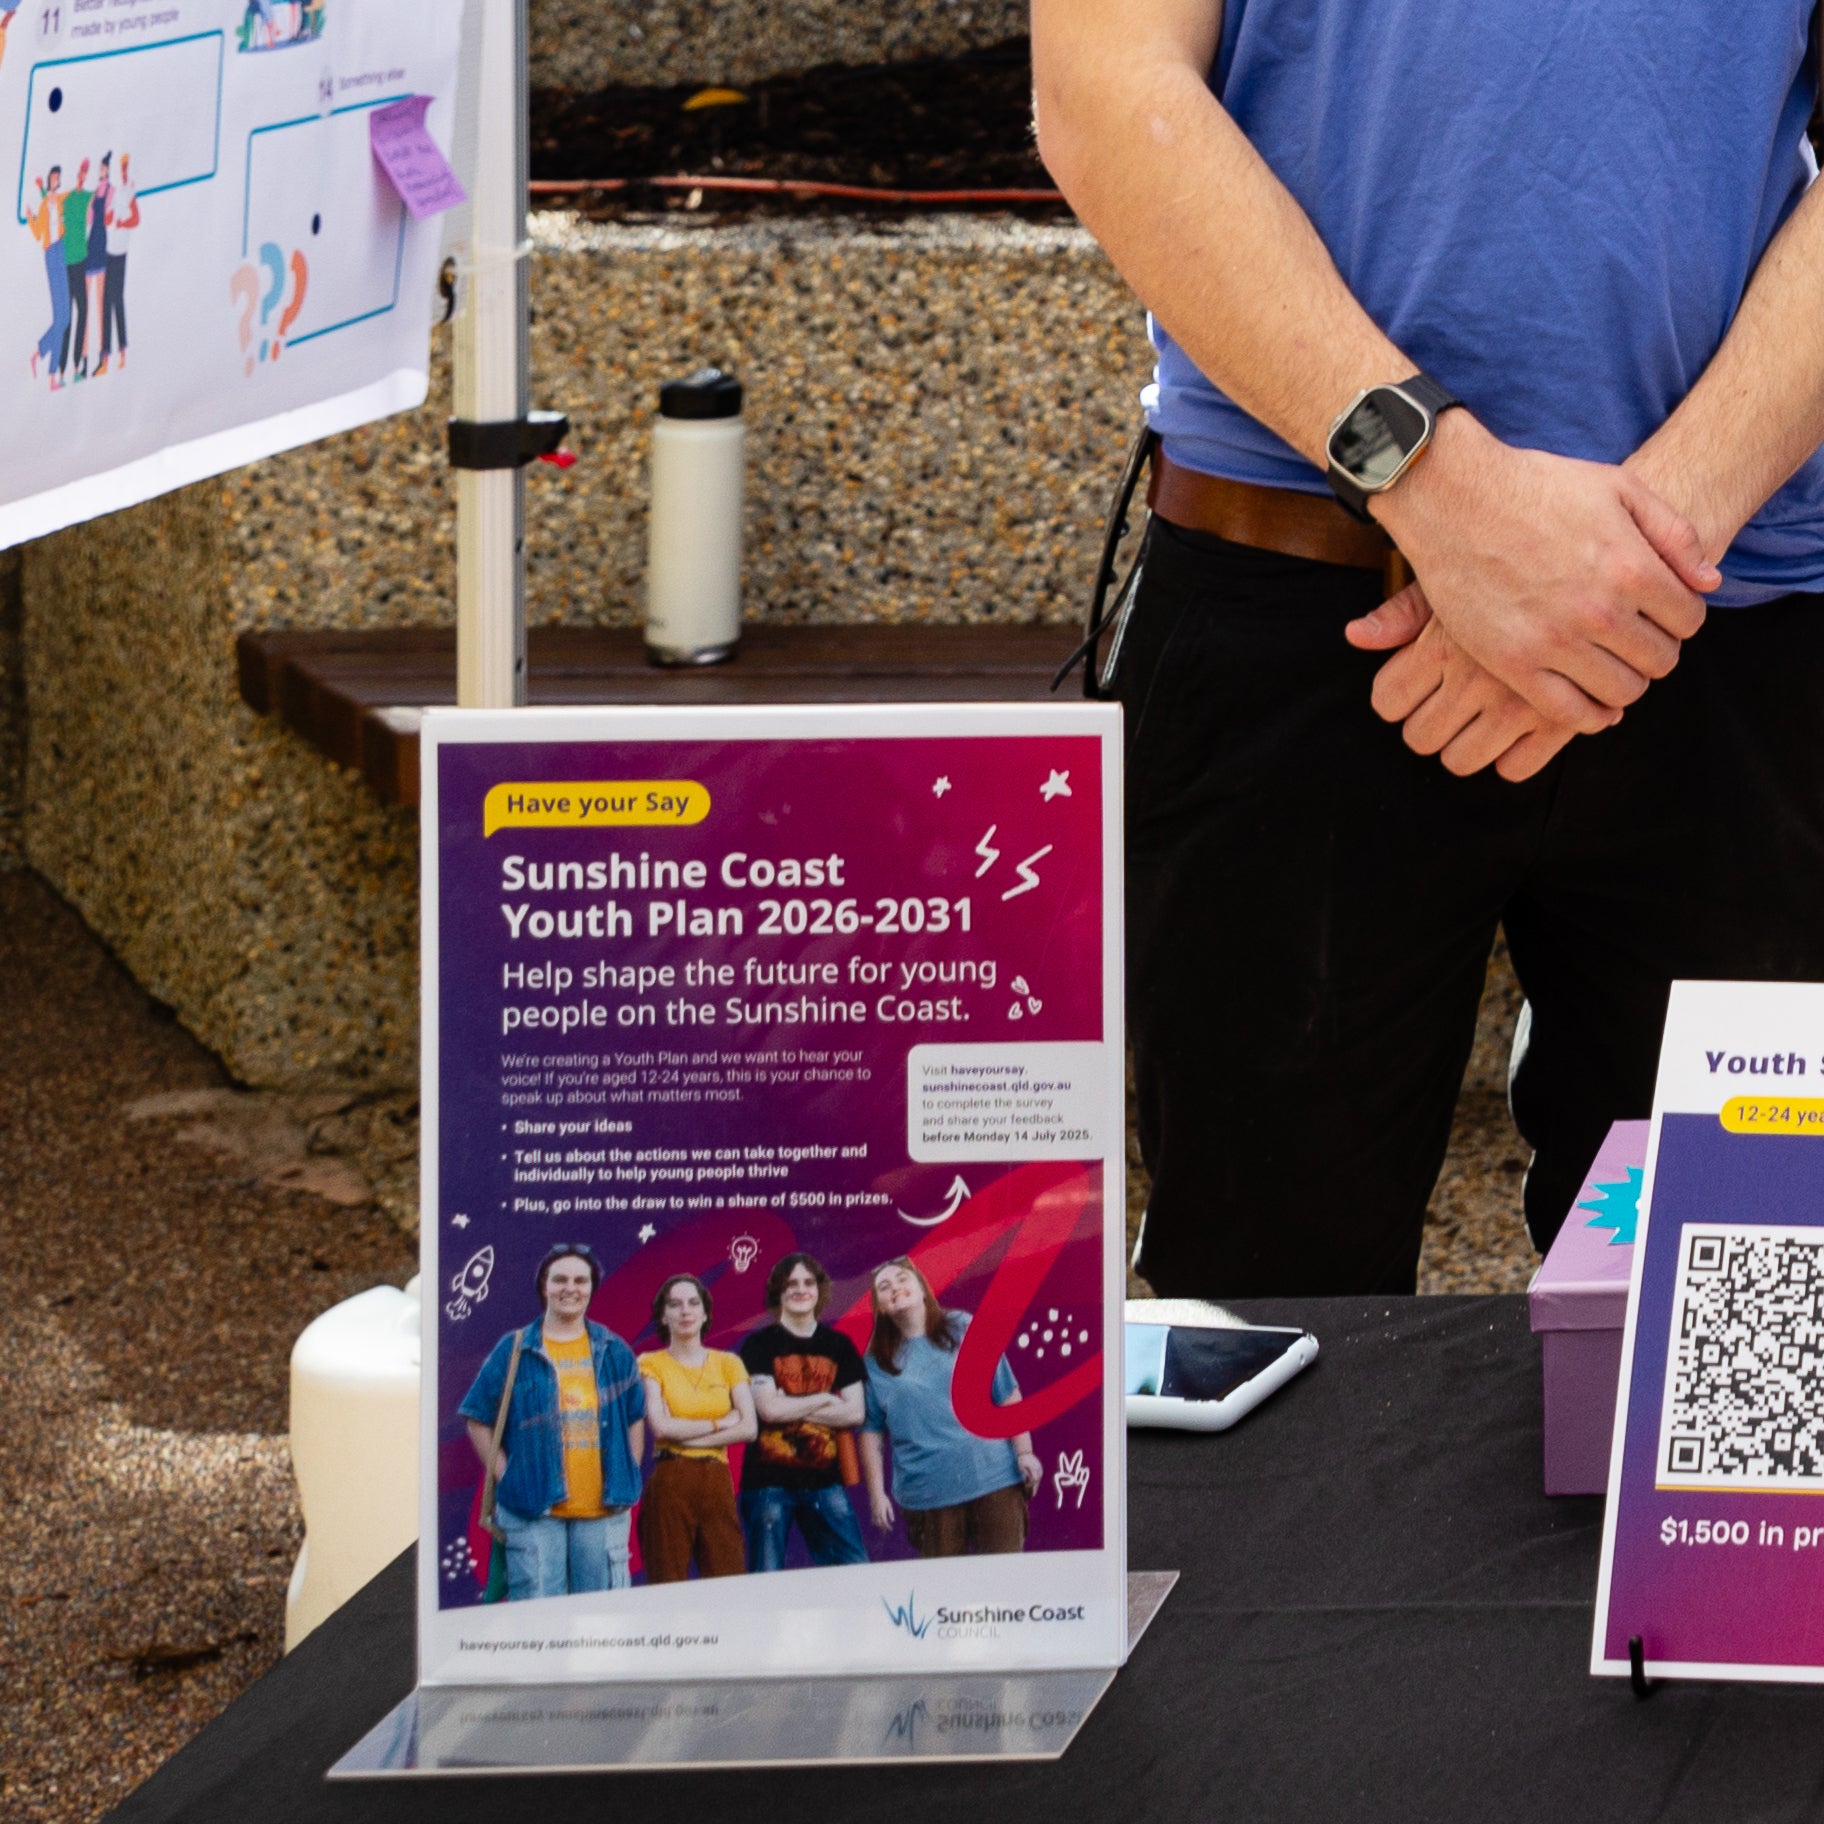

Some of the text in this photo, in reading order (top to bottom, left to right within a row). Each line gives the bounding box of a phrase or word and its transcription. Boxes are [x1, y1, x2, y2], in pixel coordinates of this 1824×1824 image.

[507, 792, 689, 819] Have your Say
[502, 852, 845, 891] Sunshine Coast
[501, 897, 971, 939] Youth Plan 2026-2031
[503, 956, 996, 996] Help shape the future for young
[503, 994, 970, 1035] people on the Sunshine Coast.
[501, 1049, 863, 1069] We're creating a Youth Plan and we want to hear your
[1705, 1051, 1806, 1075] Youth
[922, 1065, 1027, 1078] Visit haveyoursay.
[922, 1080, 1072, 1093] sunshinecoast.qld.gov.au
[502, 1088, 742, 1107] speak up about what matters most.
[1739, 1106, 1790, 1122] 12-24
[515, 1118, 633, 1136] Share your ideas
[922, 1129, 1092, 1144] before Monday 14 July 2025.
[515, 1143, 868, 1164] Tell us about the actions we can take together and
[514, 1163, 789, 1184] individually to help young people thrive
[514, 1191, 893, 1214] Plus, go into the draw to win a share of $500 in prizes.
[1660, 1516, 1750, 1546] $1,500
[1759, 1520, 1784, 1546] in
[936, 1605, 1084, 1624] Sunshine Coast
[937, 1625, 1001, 1640] COUNCIL
